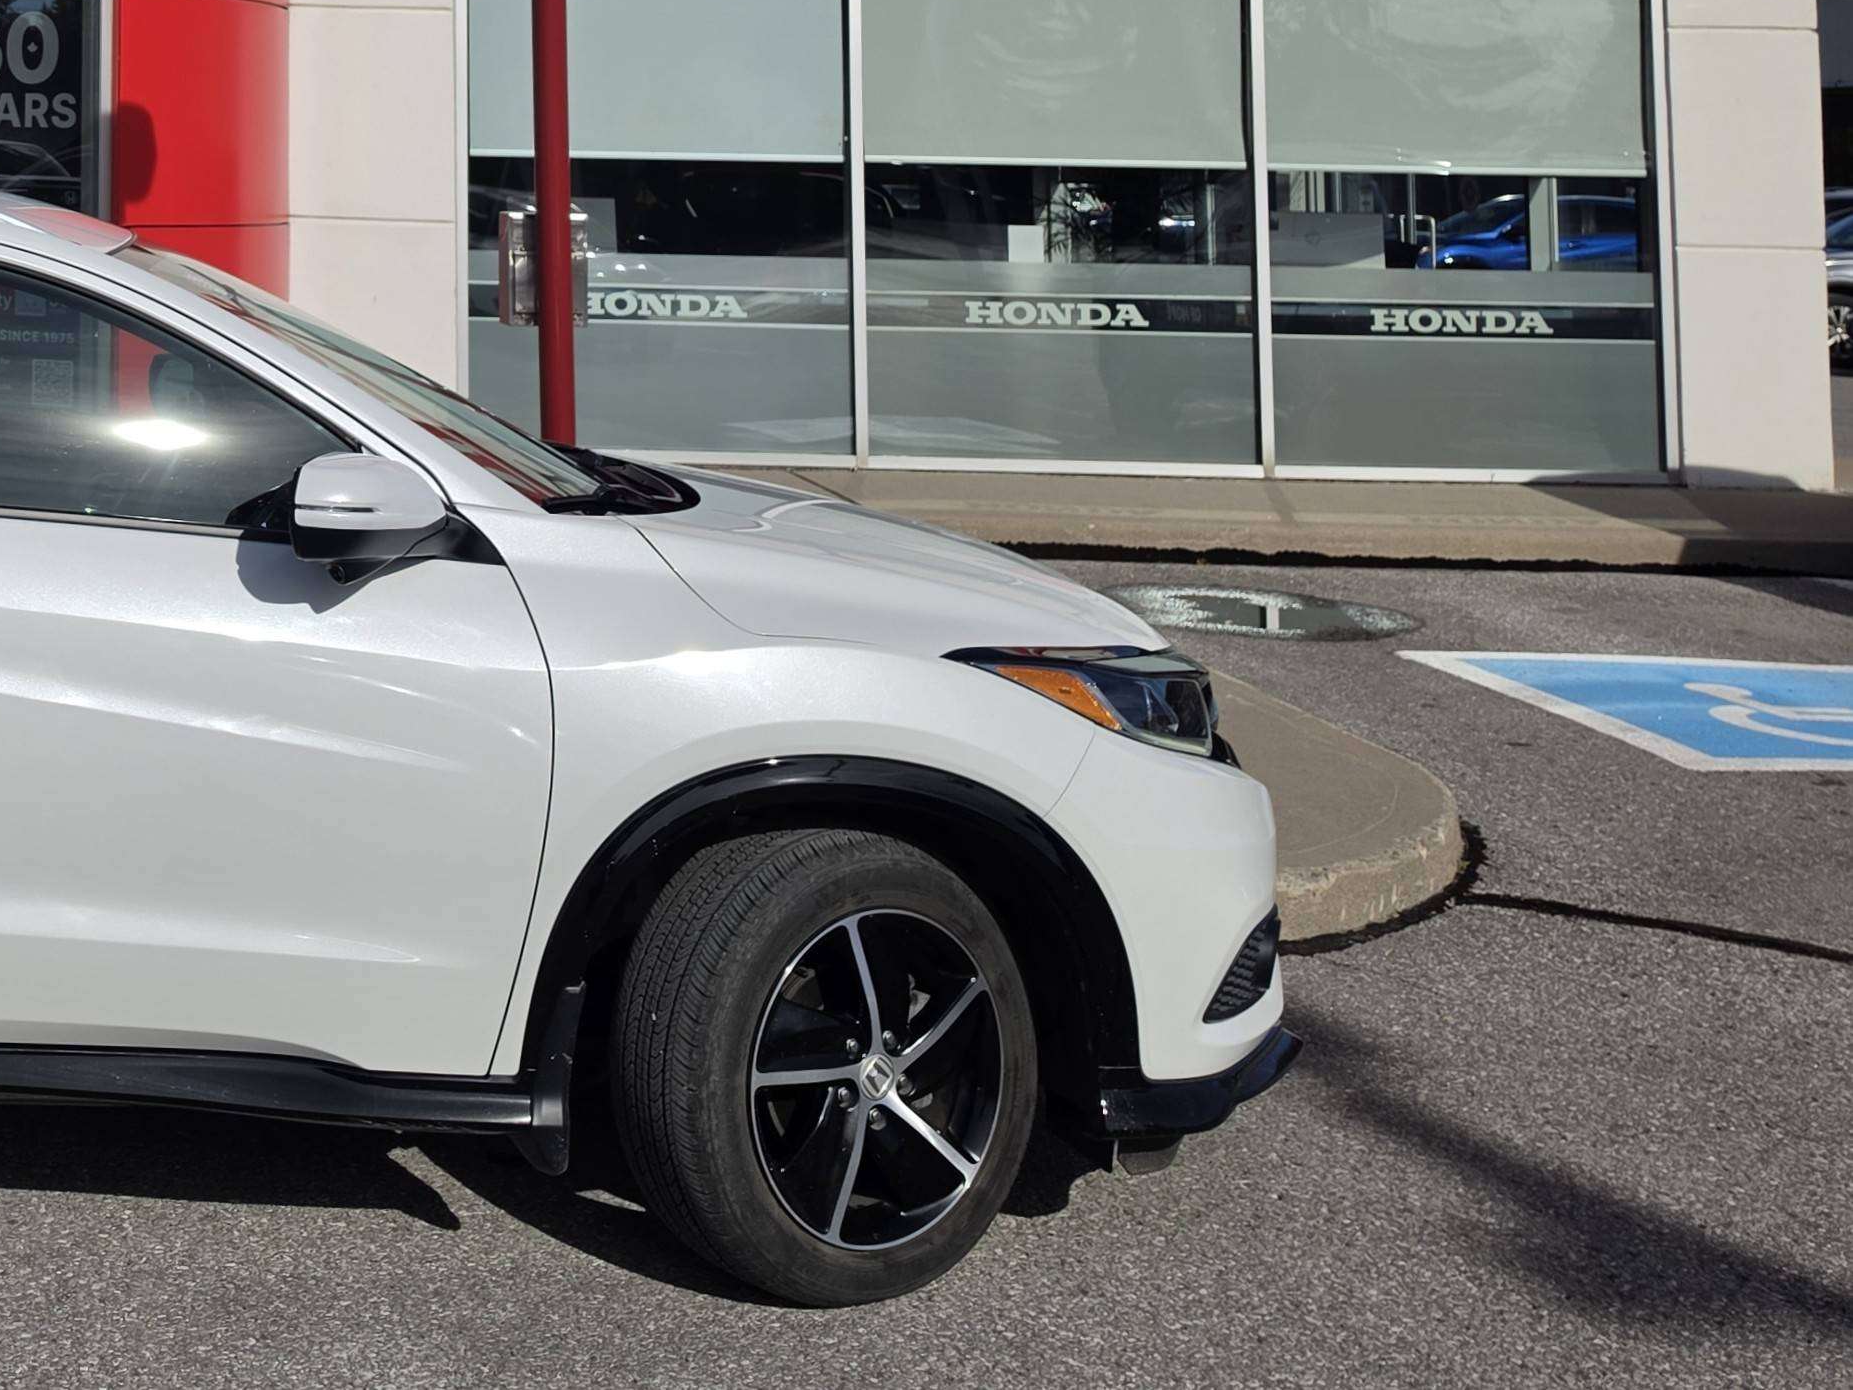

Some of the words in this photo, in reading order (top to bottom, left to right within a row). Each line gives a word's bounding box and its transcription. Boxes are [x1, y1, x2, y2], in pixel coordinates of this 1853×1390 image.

[965, 300, 1150, 327] HONDA
[1370, 308, 1554, 334] HONDA
[0, 328, 40, 343] SINCE
[42, 331, 75, 345] 1975
